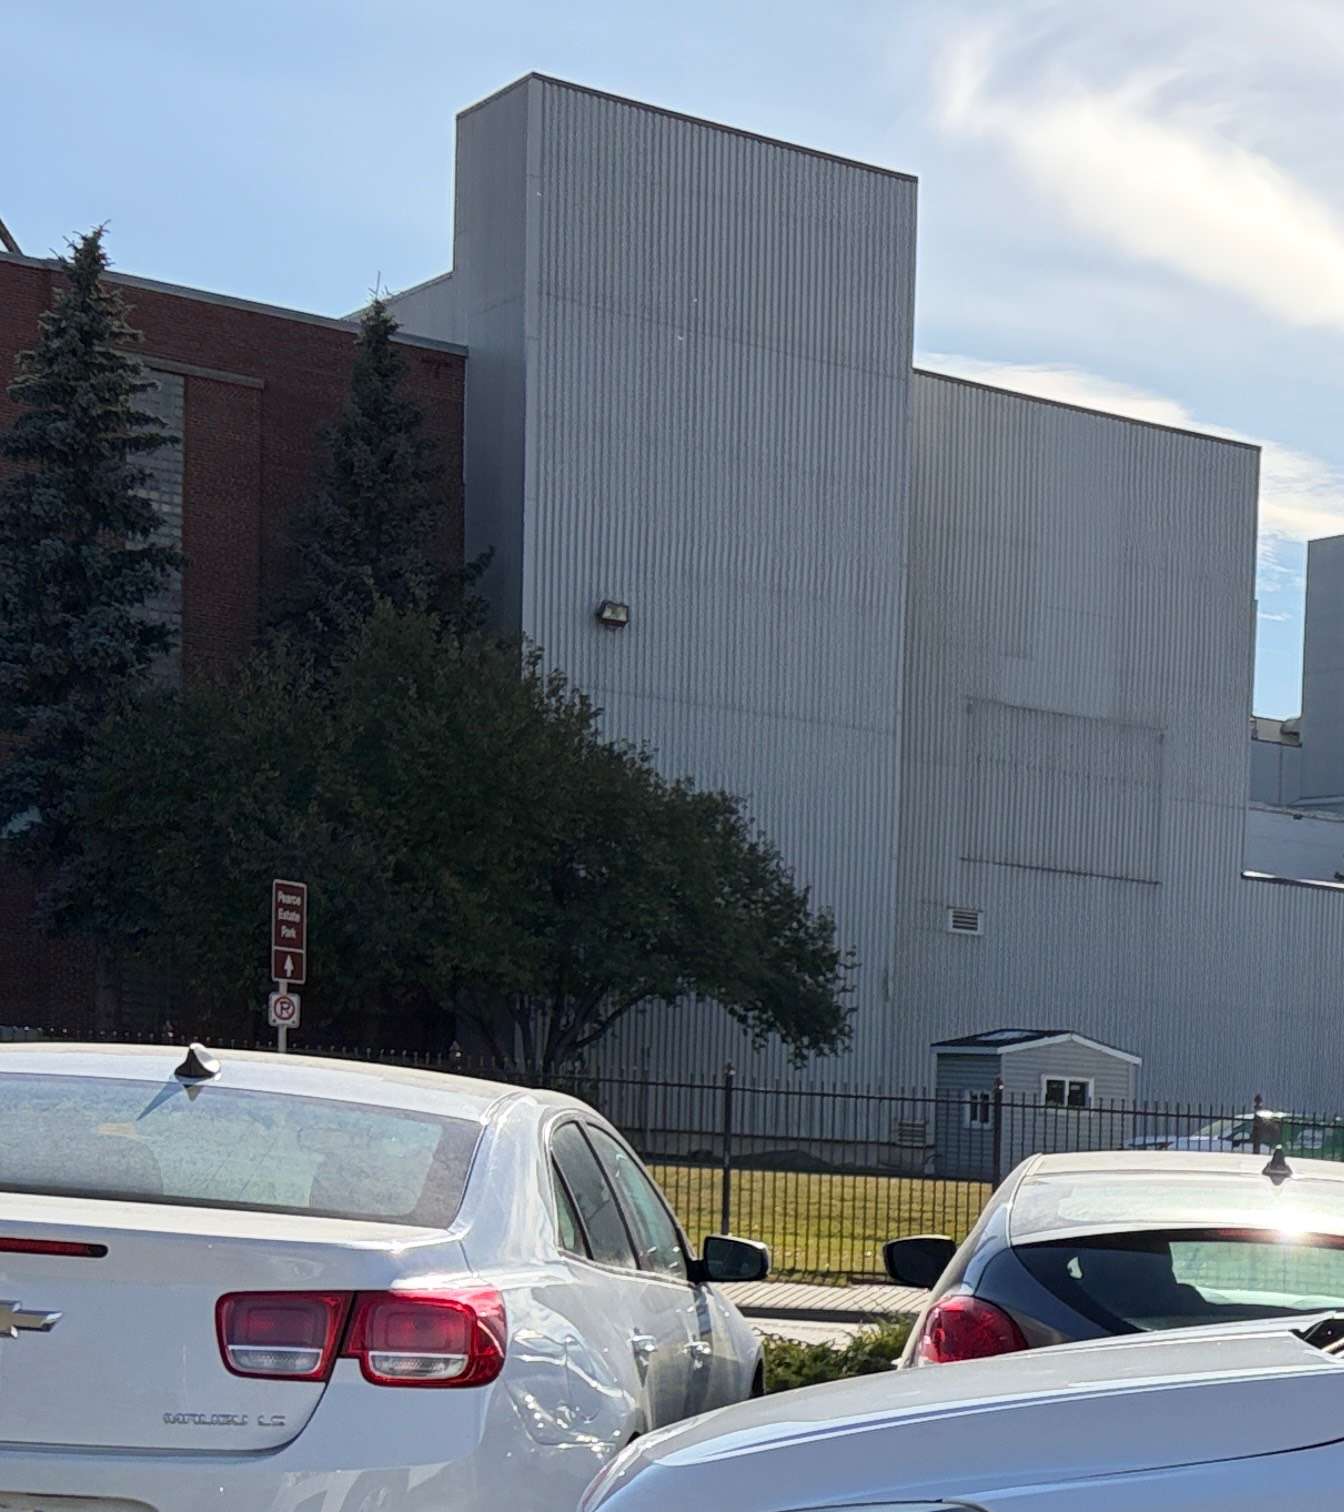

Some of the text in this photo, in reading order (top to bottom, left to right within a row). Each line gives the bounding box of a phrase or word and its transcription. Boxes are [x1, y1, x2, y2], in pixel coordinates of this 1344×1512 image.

[277, 890, 301, 907] Pearce
[278, 907, 301, 923] Estate
[281, 925, 297, 939] Park
